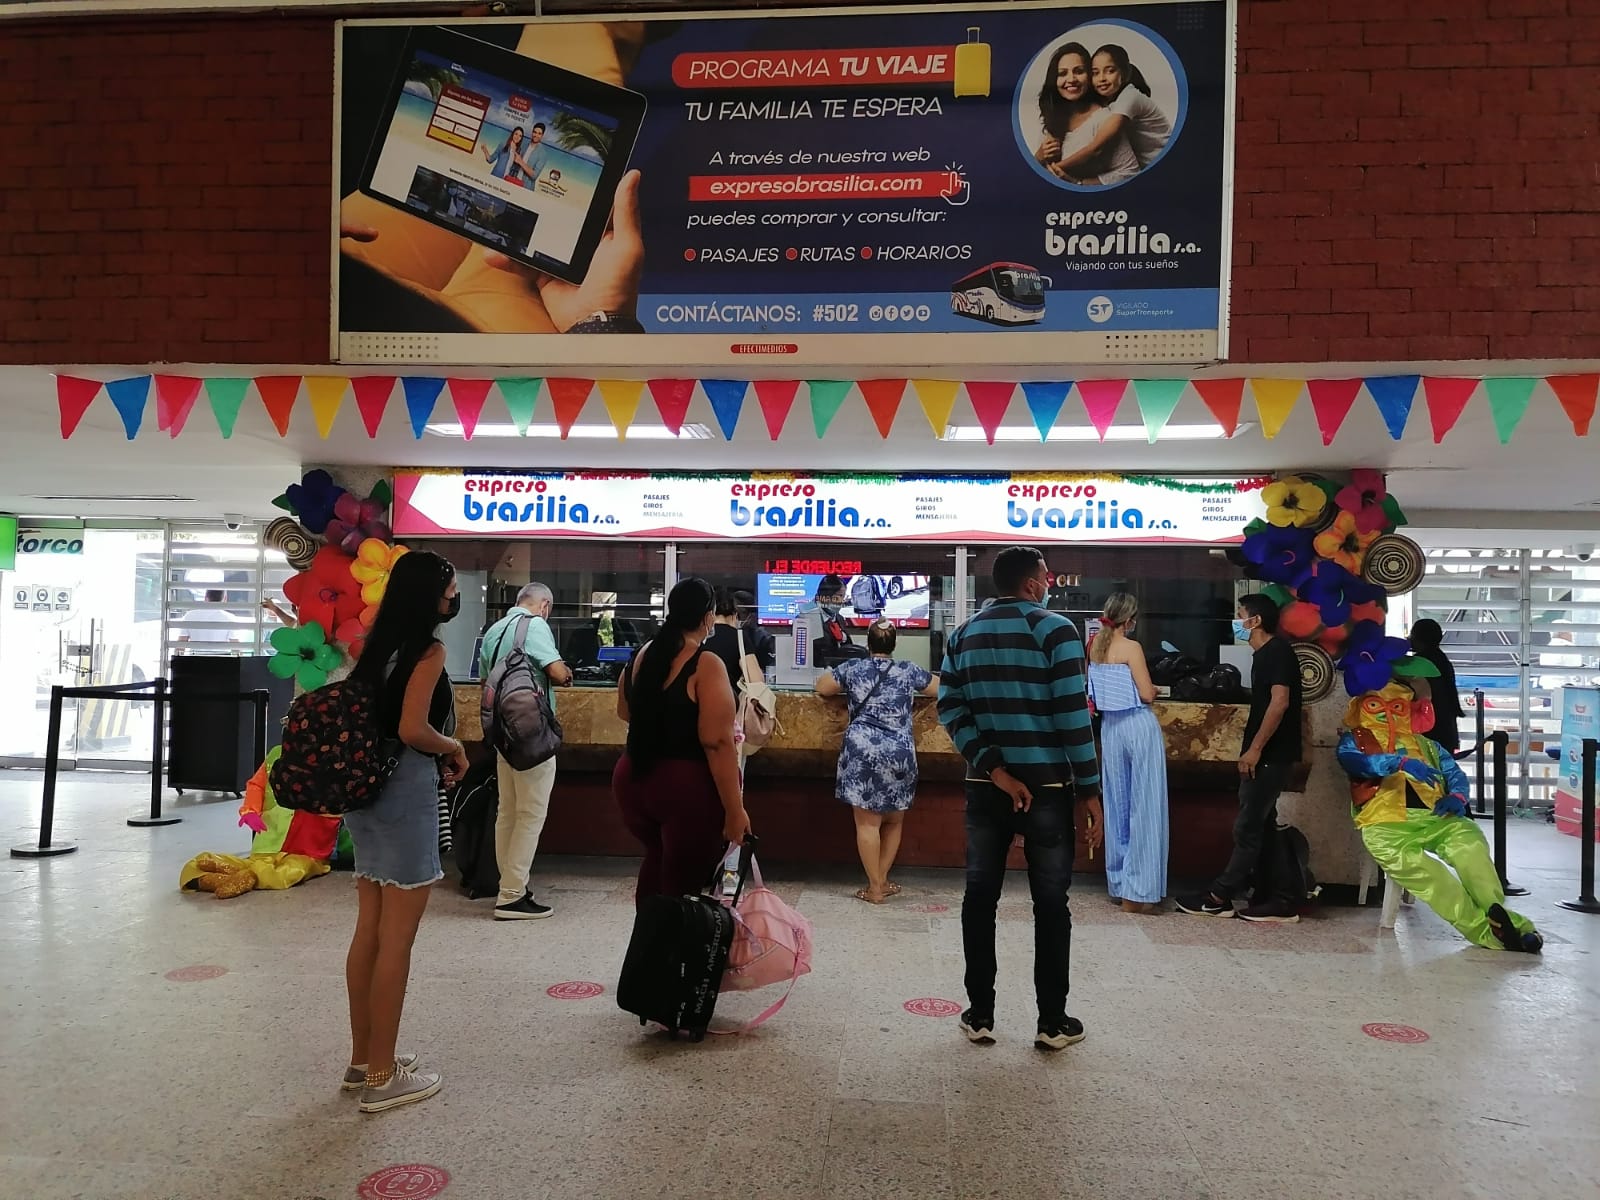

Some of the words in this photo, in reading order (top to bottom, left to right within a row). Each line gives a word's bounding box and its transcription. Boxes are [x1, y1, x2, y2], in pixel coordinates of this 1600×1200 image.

[689, 58, 830, 79] PROGRAMA
[839, 56, 869, 76] TU
[876, 54, 947, 75] VIAJE
[685, 102, 713, 121] TU
[718, 100, 813, 120] FAMILIA
[821, 99, 848, 118] TE
[852, 97, 943, 118] ESPERA
[708, 151, 724, 165] A
[728, 150, 783, 165] través
[788, 149, 813, 164] de
[817, 148, 887, 163] nuestra
[891, 147, 931, 162] web
[710, 175, 923, 198] expresobrasilia.com
[687, 210, 756, 229] puedes
[760, 211, 837, 228] comprar
[841, 211, 853, 226] y
[857, 208, 947, 224] consultar:
[1045, 210, 1128, 229] expreso
[1045, 225, 1171, 256] brasilia
[1173, 242, 1202, 254] s.a.
[700, 248, 780, 262] PASAJES
[800, 247, 856, 262] RUTAS
[877, 245, 972, 261] HORARIOS
[1066, 261, 1106, 273] Viajando
[1108, 262, 1125, 270] con
[1128, 260, 1143, 270] tus
[1145, 259, 1179, 269] sueños
[656, 301, 801, 323] CONTÁCTANOS:
[812, 304, 859, 322] #502
[1090, 304, 1110, 316] ST
[739, 344, 788, 353] EFECTIMEDIOS
[464, 479, 547, 496] expreso
[730, 483, 816, 501] expreso
[1007, 485, 1097, 502] expreso
[464, 494, 589, 524] brasilia
[592, 514, 620, 525] s.a.
[730, 498, 860, 527] brasilia
[863, 518, 892, 528] s.a.
[1007, 500, 1143, 529] brasilia
[1148, 519, 1178, 529] s.a.
[1202, 513, 1247, 522] MENSAJERÍA
